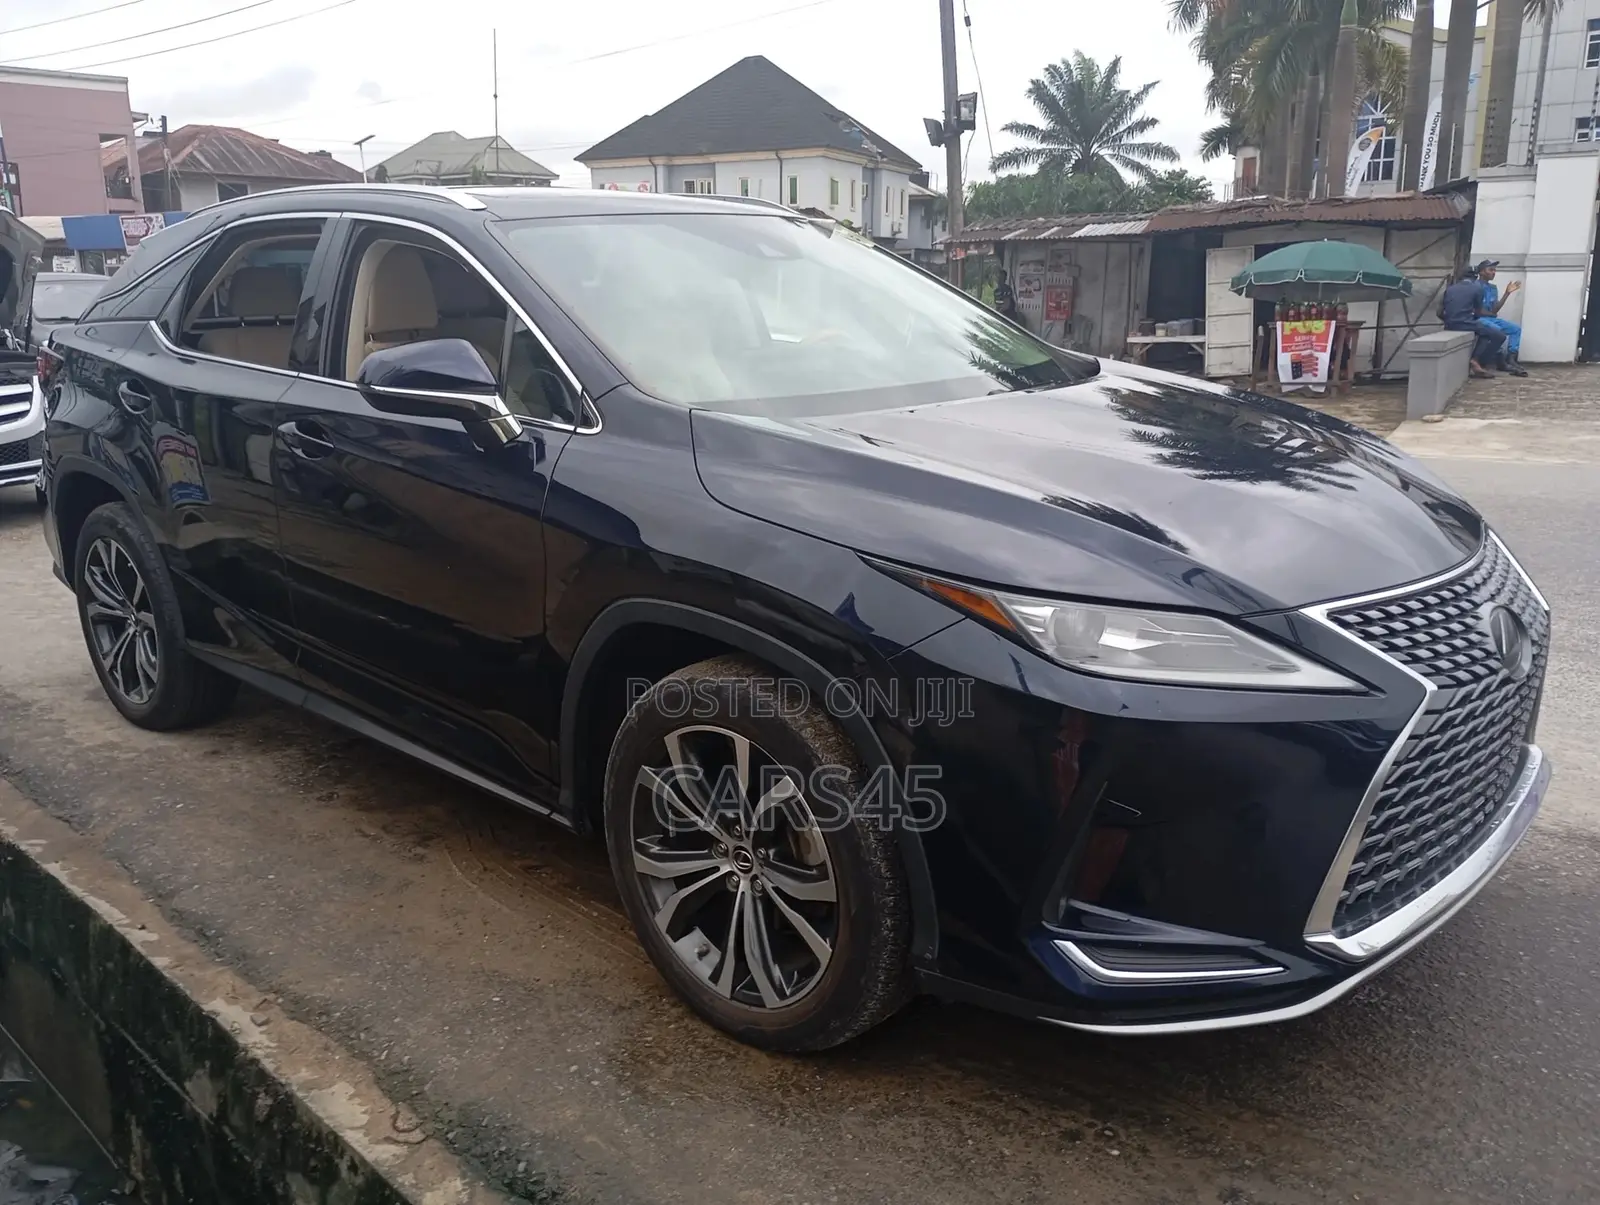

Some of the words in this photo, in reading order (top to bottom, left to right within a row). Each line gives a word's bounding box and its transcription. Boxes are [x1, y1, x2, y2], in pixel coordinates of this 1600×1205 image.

[1429, 111, 1442, 136] MUCH
[1427, 136, 1434, 147] SO
[1422, 148, 1432, 165] YOU
